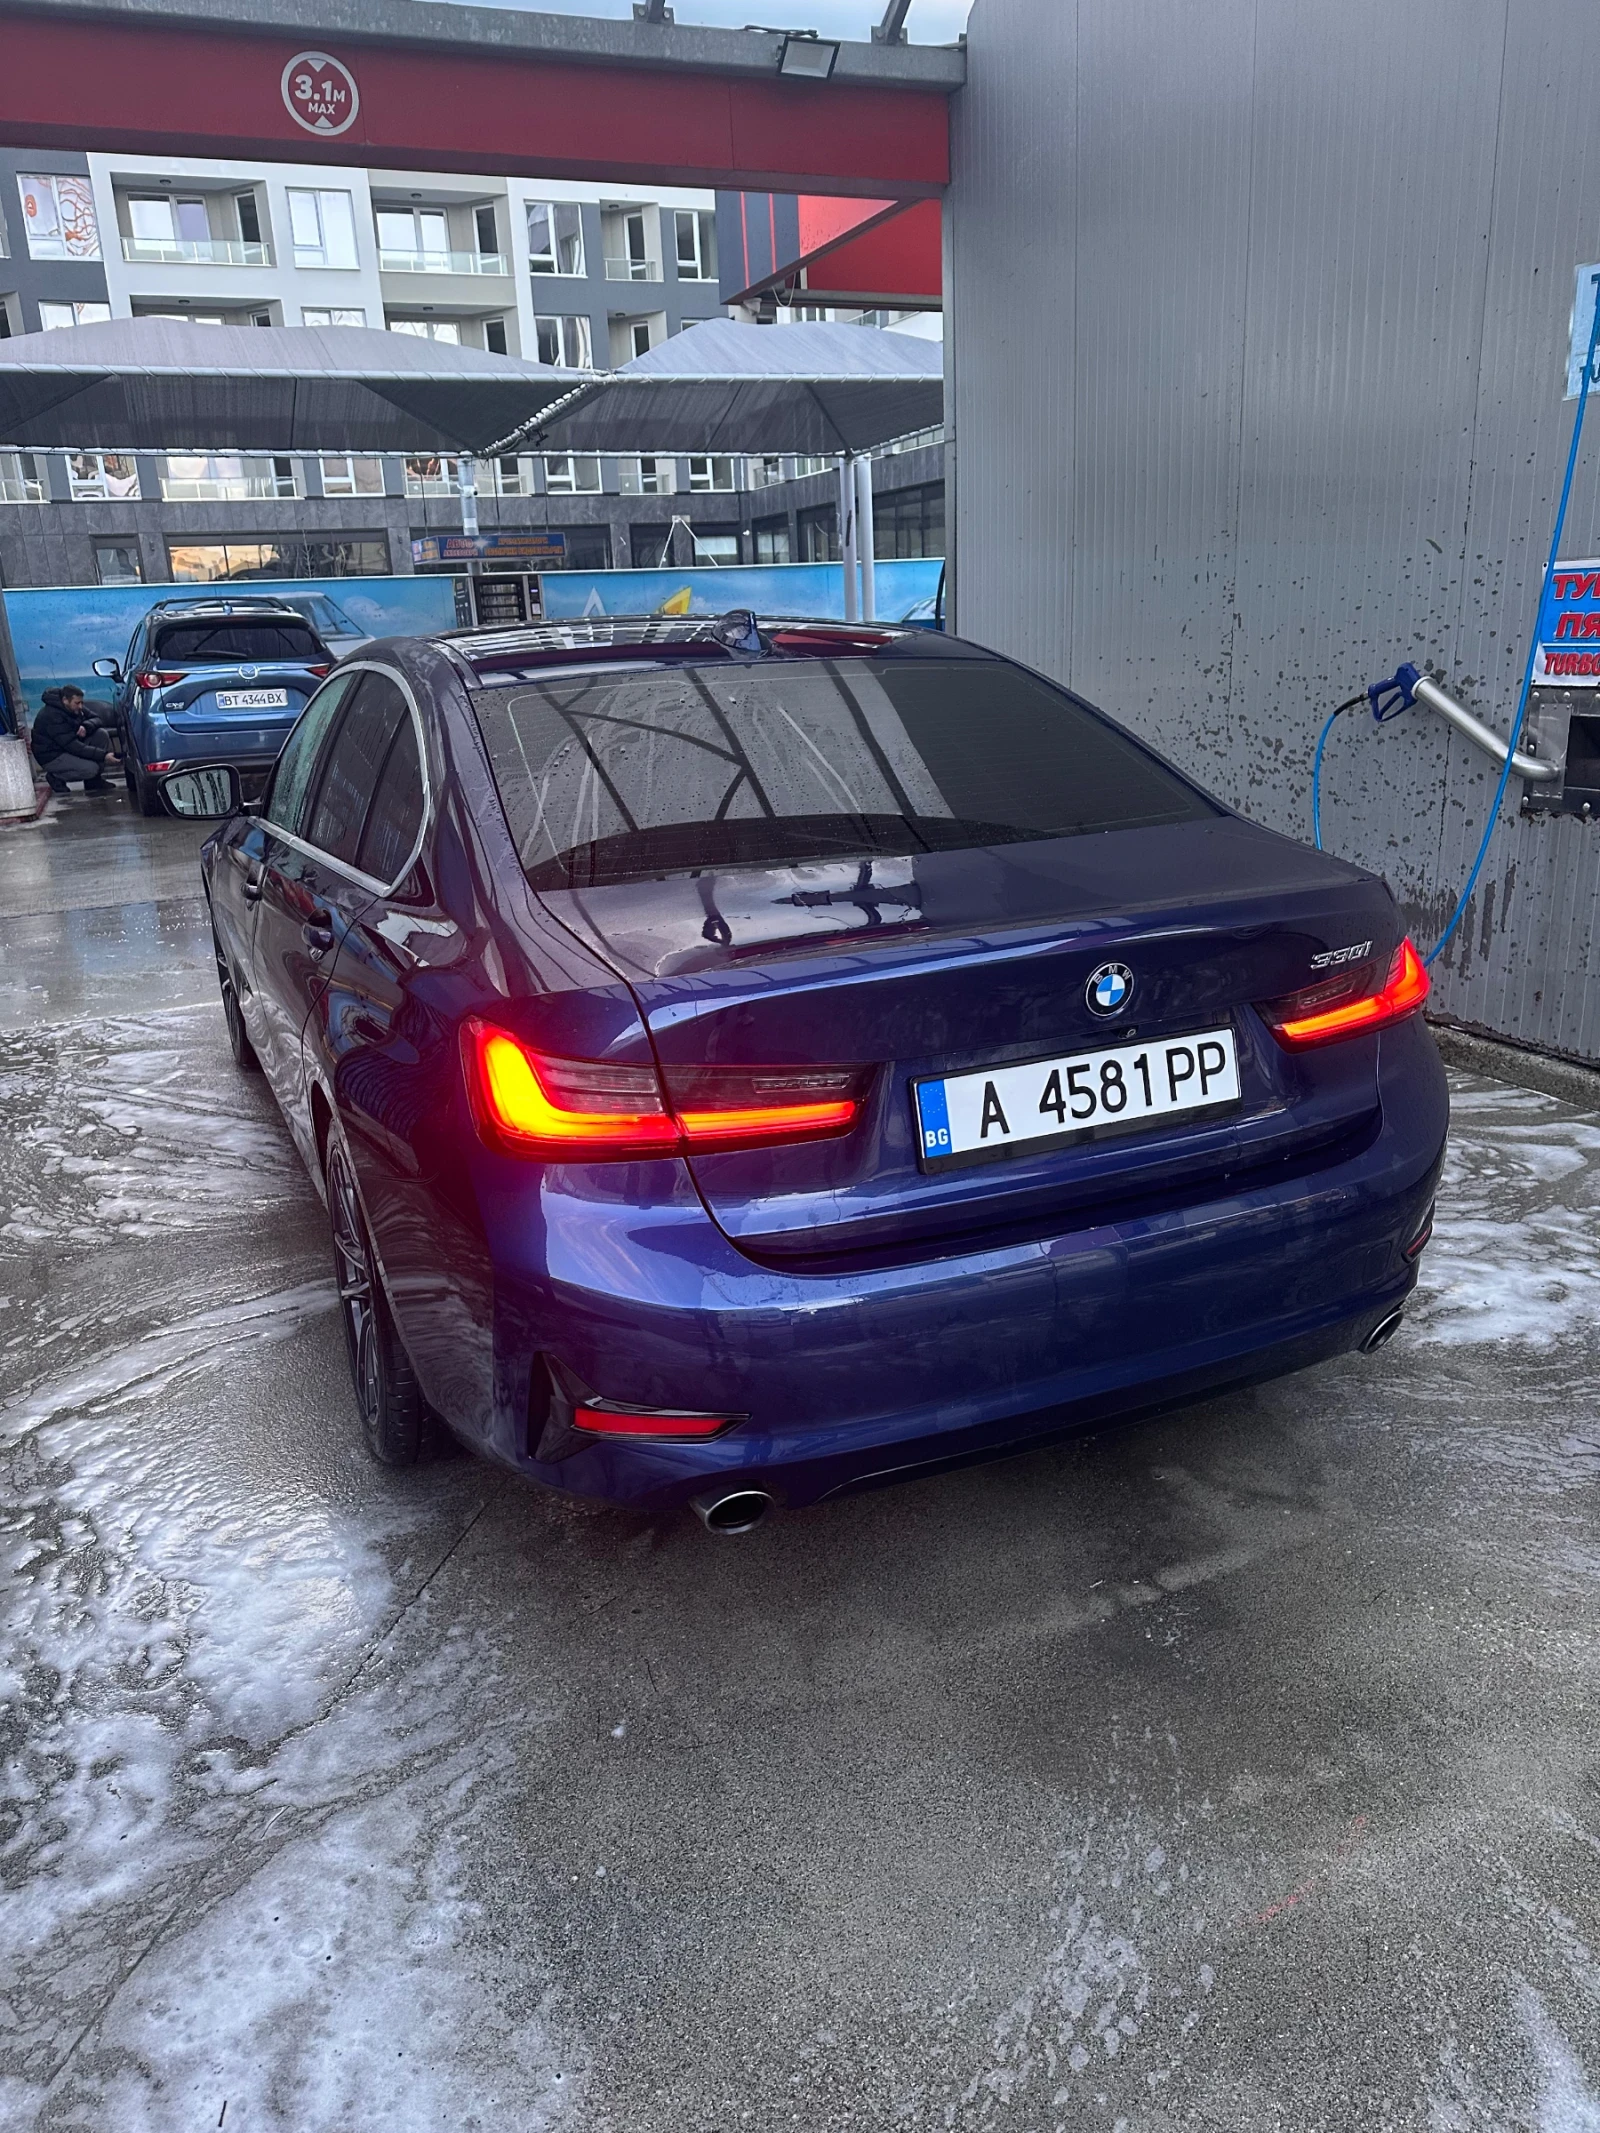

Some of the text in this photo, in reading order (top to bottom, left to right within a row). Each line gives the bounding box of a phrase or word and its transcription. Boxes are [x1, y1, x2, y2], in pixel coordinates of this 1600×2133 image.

[308, 102, 335, 114] MAX
[225, 693, 283, 706] BT 4344 BX
[1093, 964, 1131, 985] BMW
[925, 1041, 1227, 1148] BG A 4581 PP
